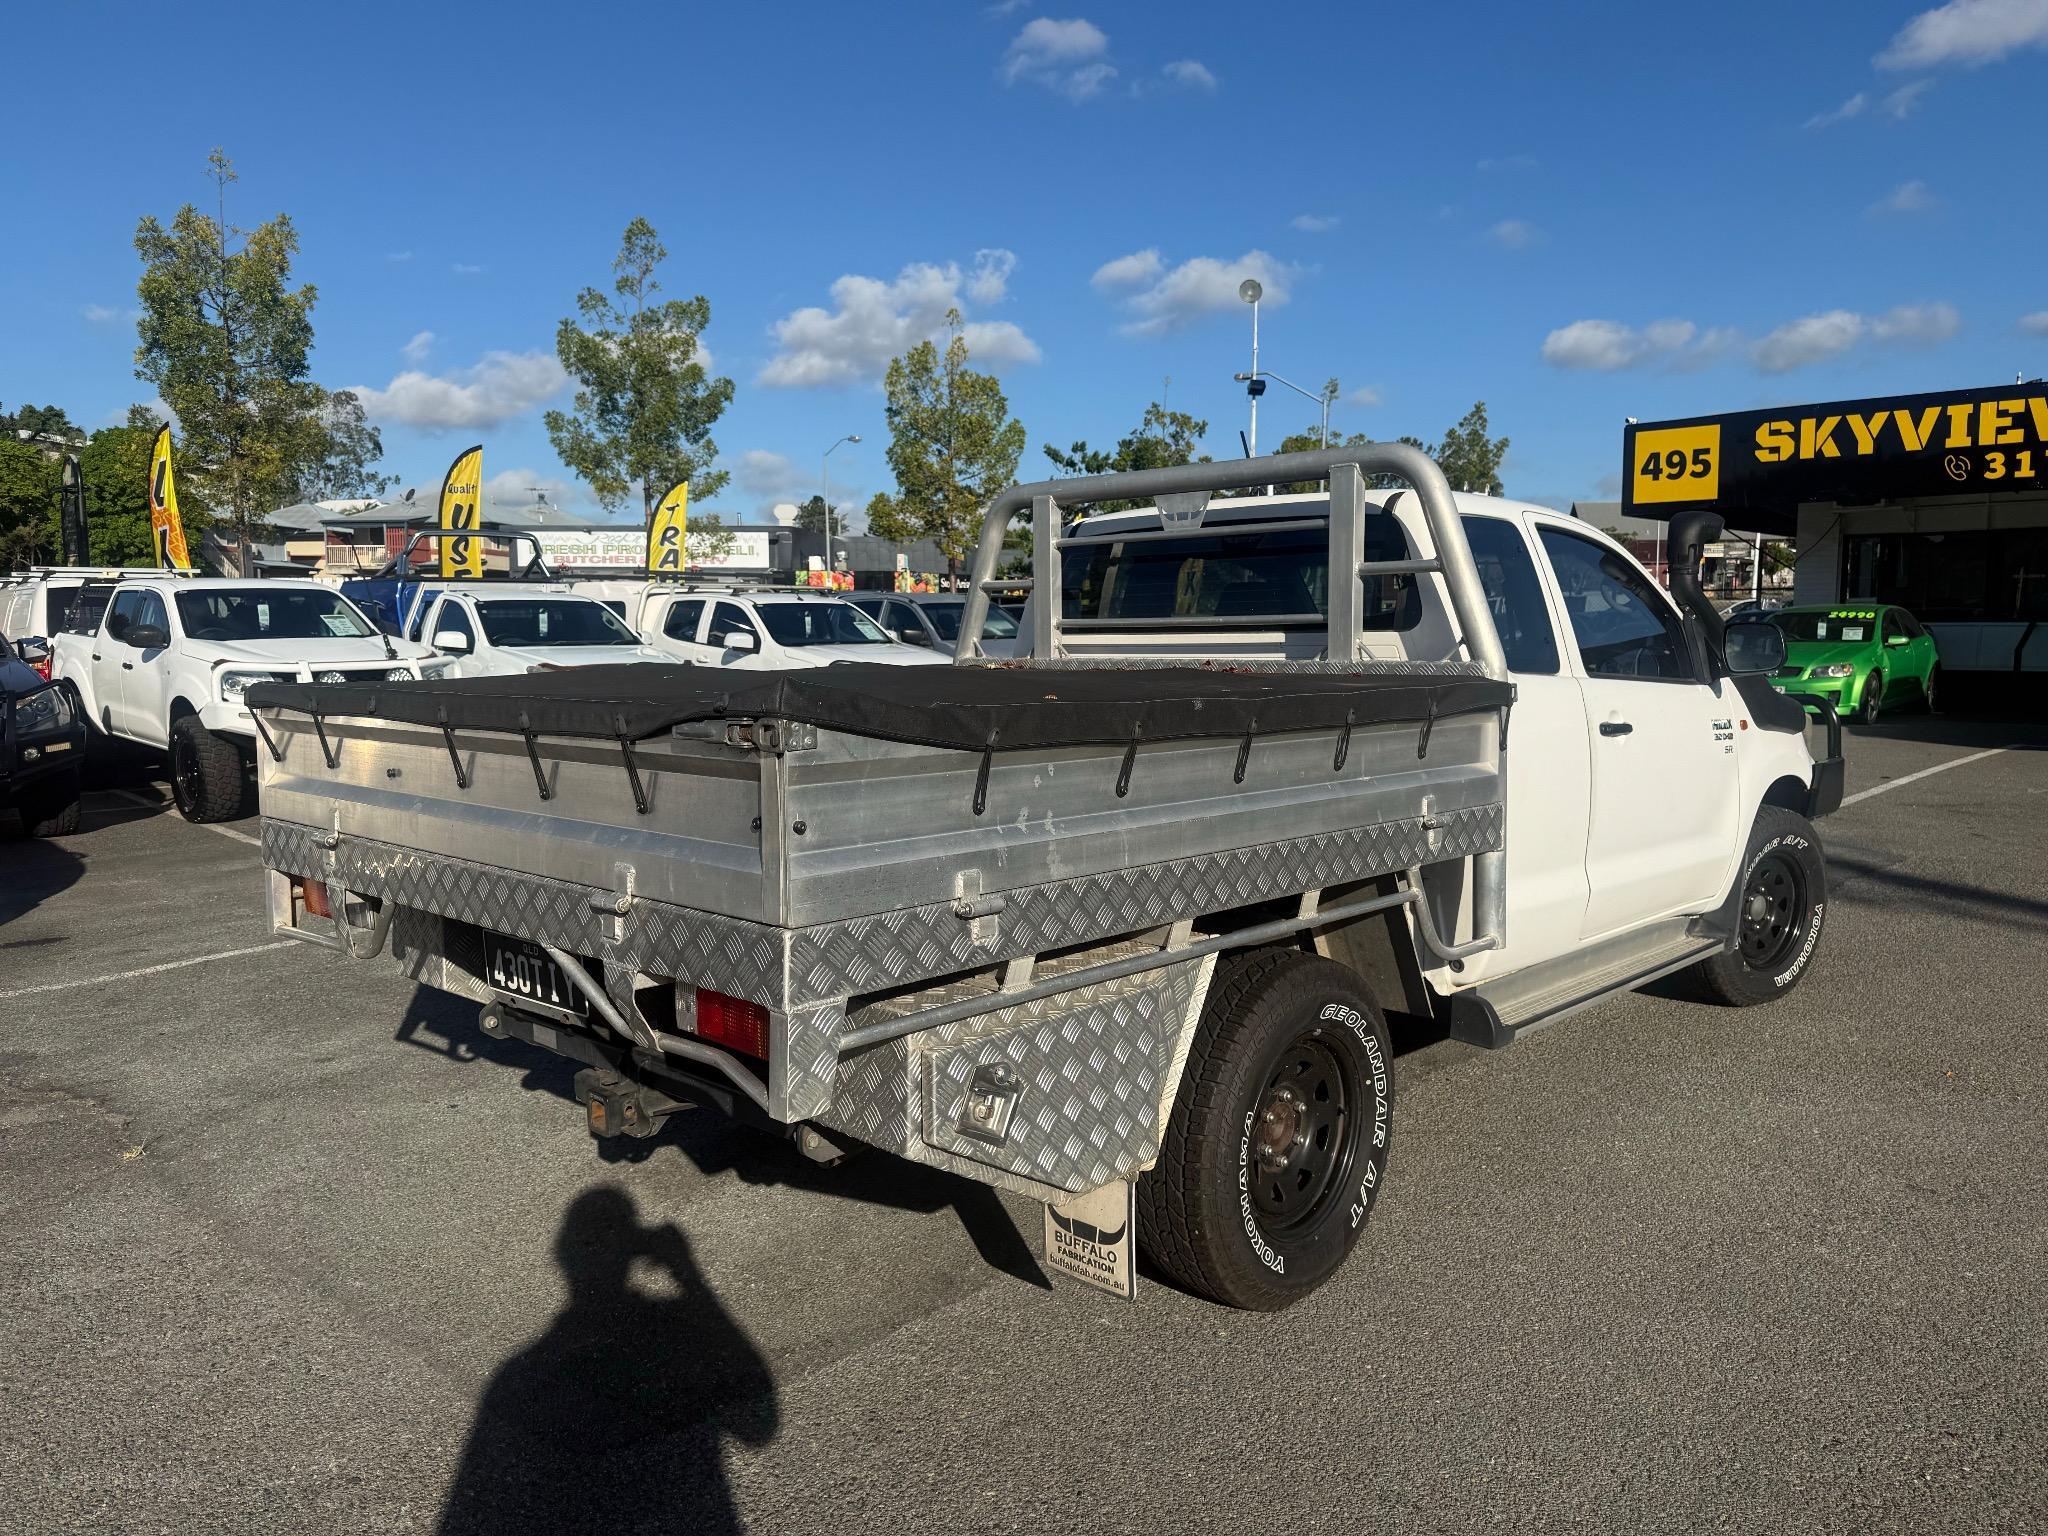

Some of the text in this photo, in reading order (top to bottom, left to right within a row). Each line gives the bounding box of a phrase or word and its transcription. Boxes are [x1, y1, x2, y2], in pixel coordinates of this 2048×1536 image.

[1640, 447, 1712, 481] 495
[1984, 450, 2048, 479] 31
[447, 483, 477, 494] Qualit
[553, 555, 637, 564] BUTCHER
[522, 943, 540, 956] QLD
[1773, 902, 1824, 987] YOKOHAMA
[1319, 1003, 1388, 1228] GEOLANDAR A/T
[1239, 1111, 1285, 1274] YOKOHAMA
[1054, 1229, 1118, 1264] BUFFALO
[1057, 1245, 1116, 1275] FABRICATION
[1049, 1252, 1126, 1291] buffalofab.com.au
